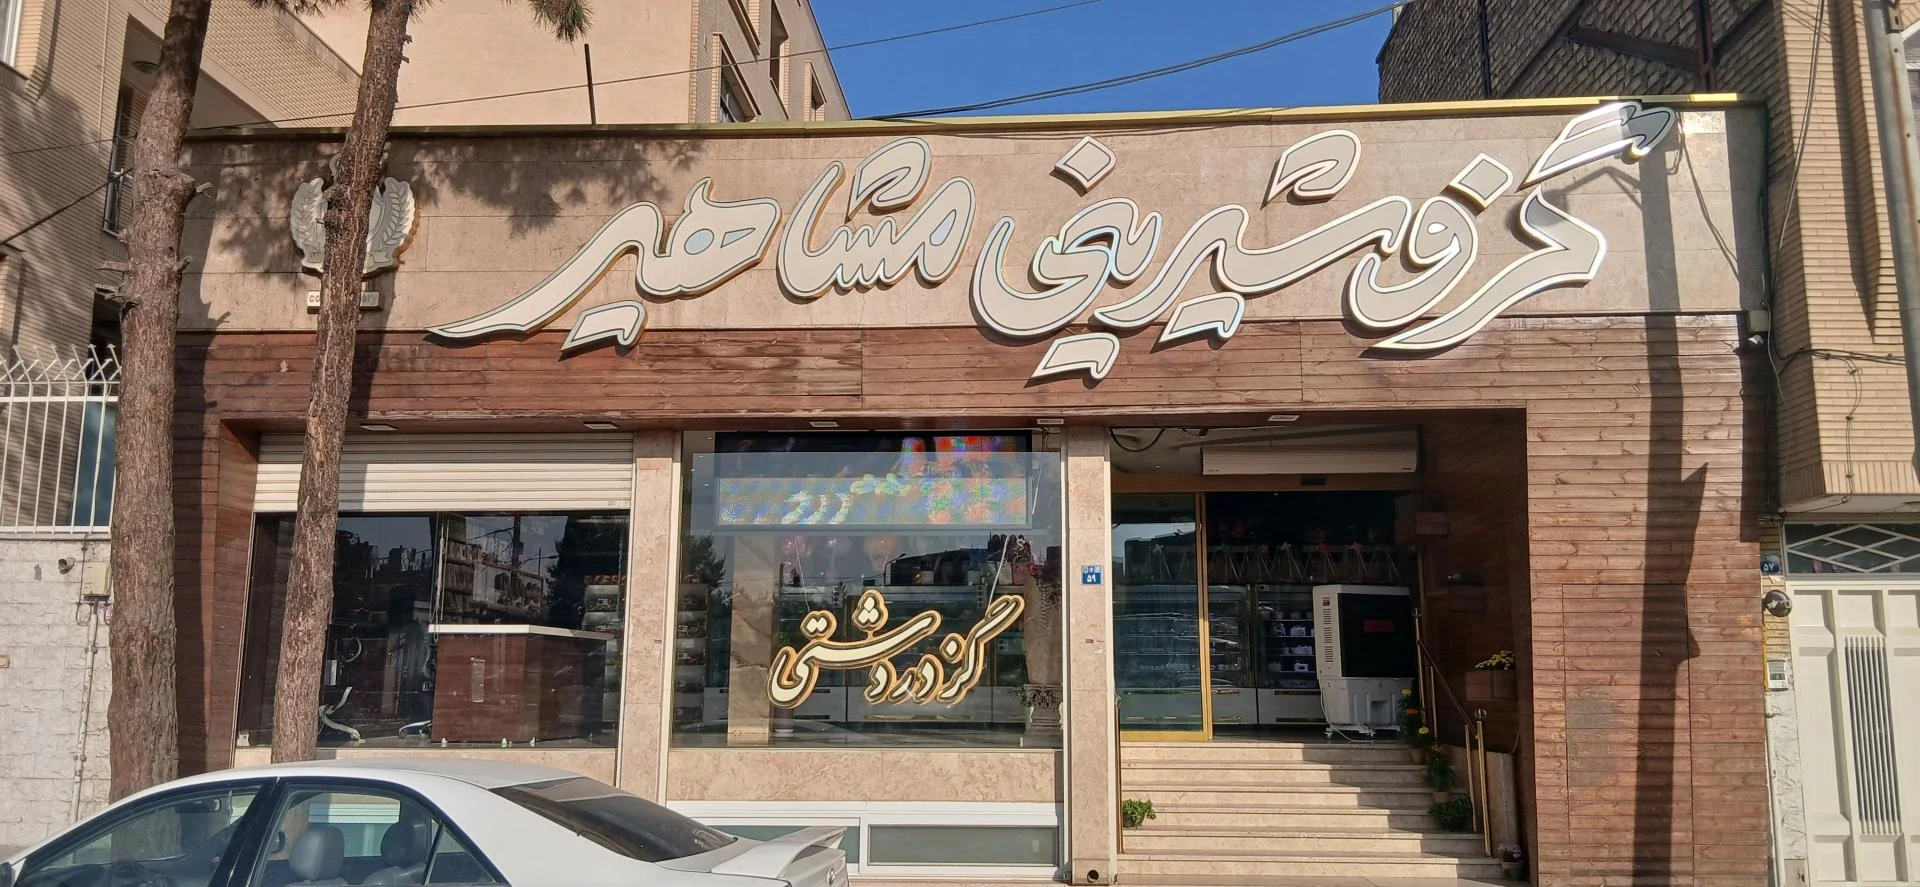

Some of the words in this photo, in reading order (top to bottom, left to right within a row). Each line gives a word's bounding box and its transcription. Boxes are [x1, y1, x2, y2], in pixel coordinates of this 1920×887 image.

[427, 137, 976, 353] مشاهیر
[973, 129, 1412, 380] شیرینی
[1349, 195, 1479, 328] و
[1372, 101, 1677, 350] گز
[1086, 573, 1097, 583] ۵۹
[767, 589, 945, 709] دردشتی
[936, 595, 1025, 705] گز
